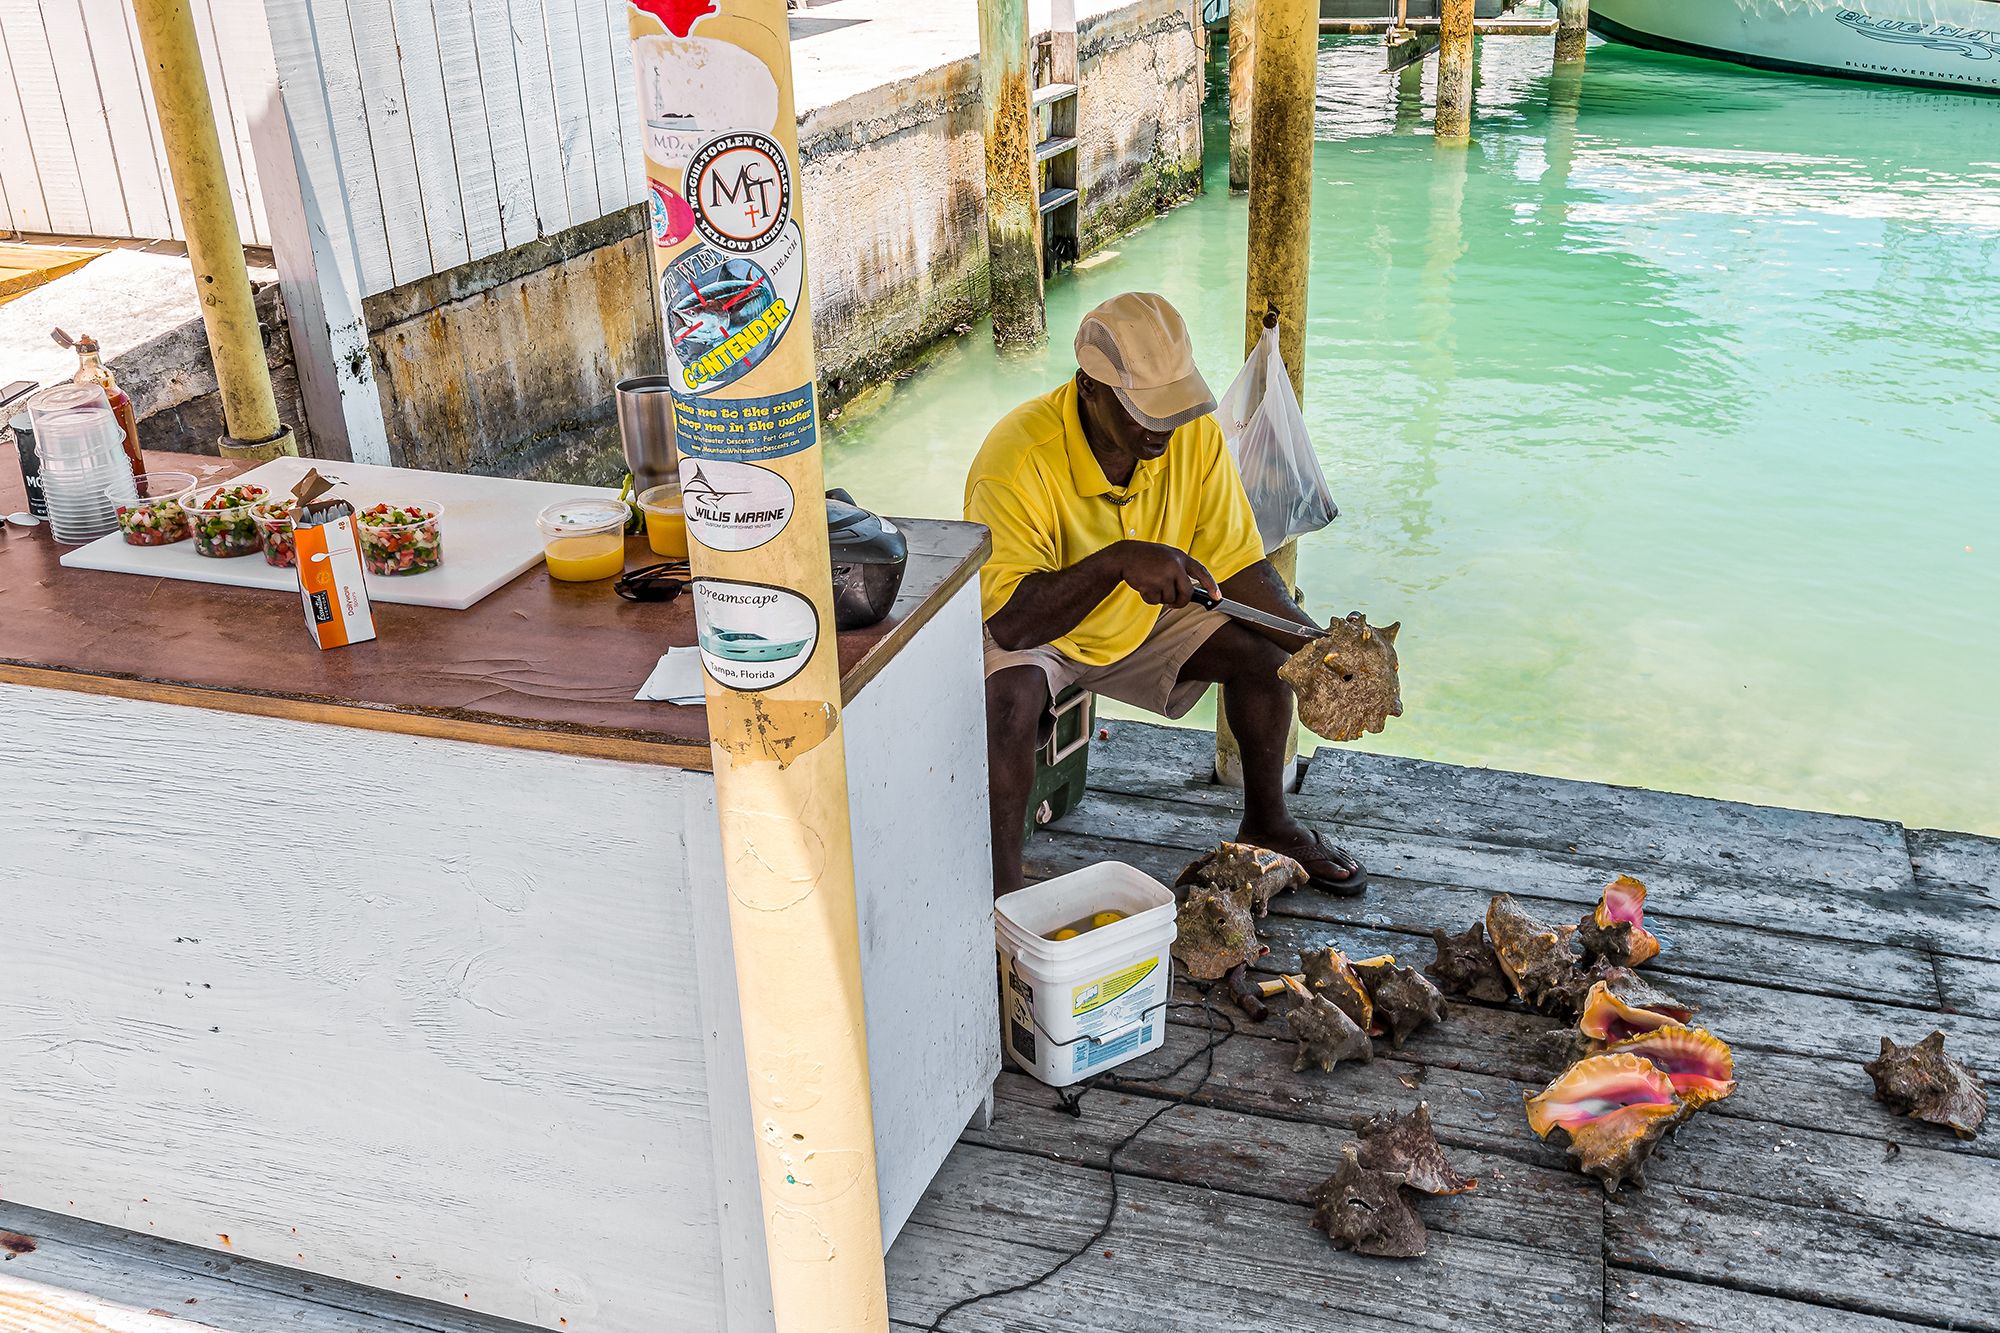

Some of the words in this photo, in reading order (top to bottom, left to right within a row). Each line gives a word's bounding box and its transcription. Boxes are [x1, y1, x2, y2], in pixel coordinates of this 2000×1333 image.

[1835, 9, 1928, 34] BLUE
[755, 138, 789, 194] CATHOLIC
[700, 219, 750, 250] YELLOW
[750, 207, 787, 251] JACKETS
[769, 240, 798, 277] BEACH
[683, 298, 791, 390] CONTENDER
[678, 413, 701, 432] Drop
[704, 423, 725, 433] me
[729, 422, 744, 433] in
[748, 420, 774, 432] the
[778, 409, 812, 428] water
[697, 407, 717, 418] me
[721, 408, 739, 418] to
[742, 406, 769, 418] the
[726, 436, 754, 445] Descents
[763, 434, 777, 442] Fort
[695, 505, 731, 523] WILLIS
[734, 507, 785, 523] MARINE
[704, 521, 722, 529] CUSTOM
[698, 583, 779, 608] Dreamscape
[710, 661, 738, 678] Tampa,
[740, 669, 775, 679] Florida
